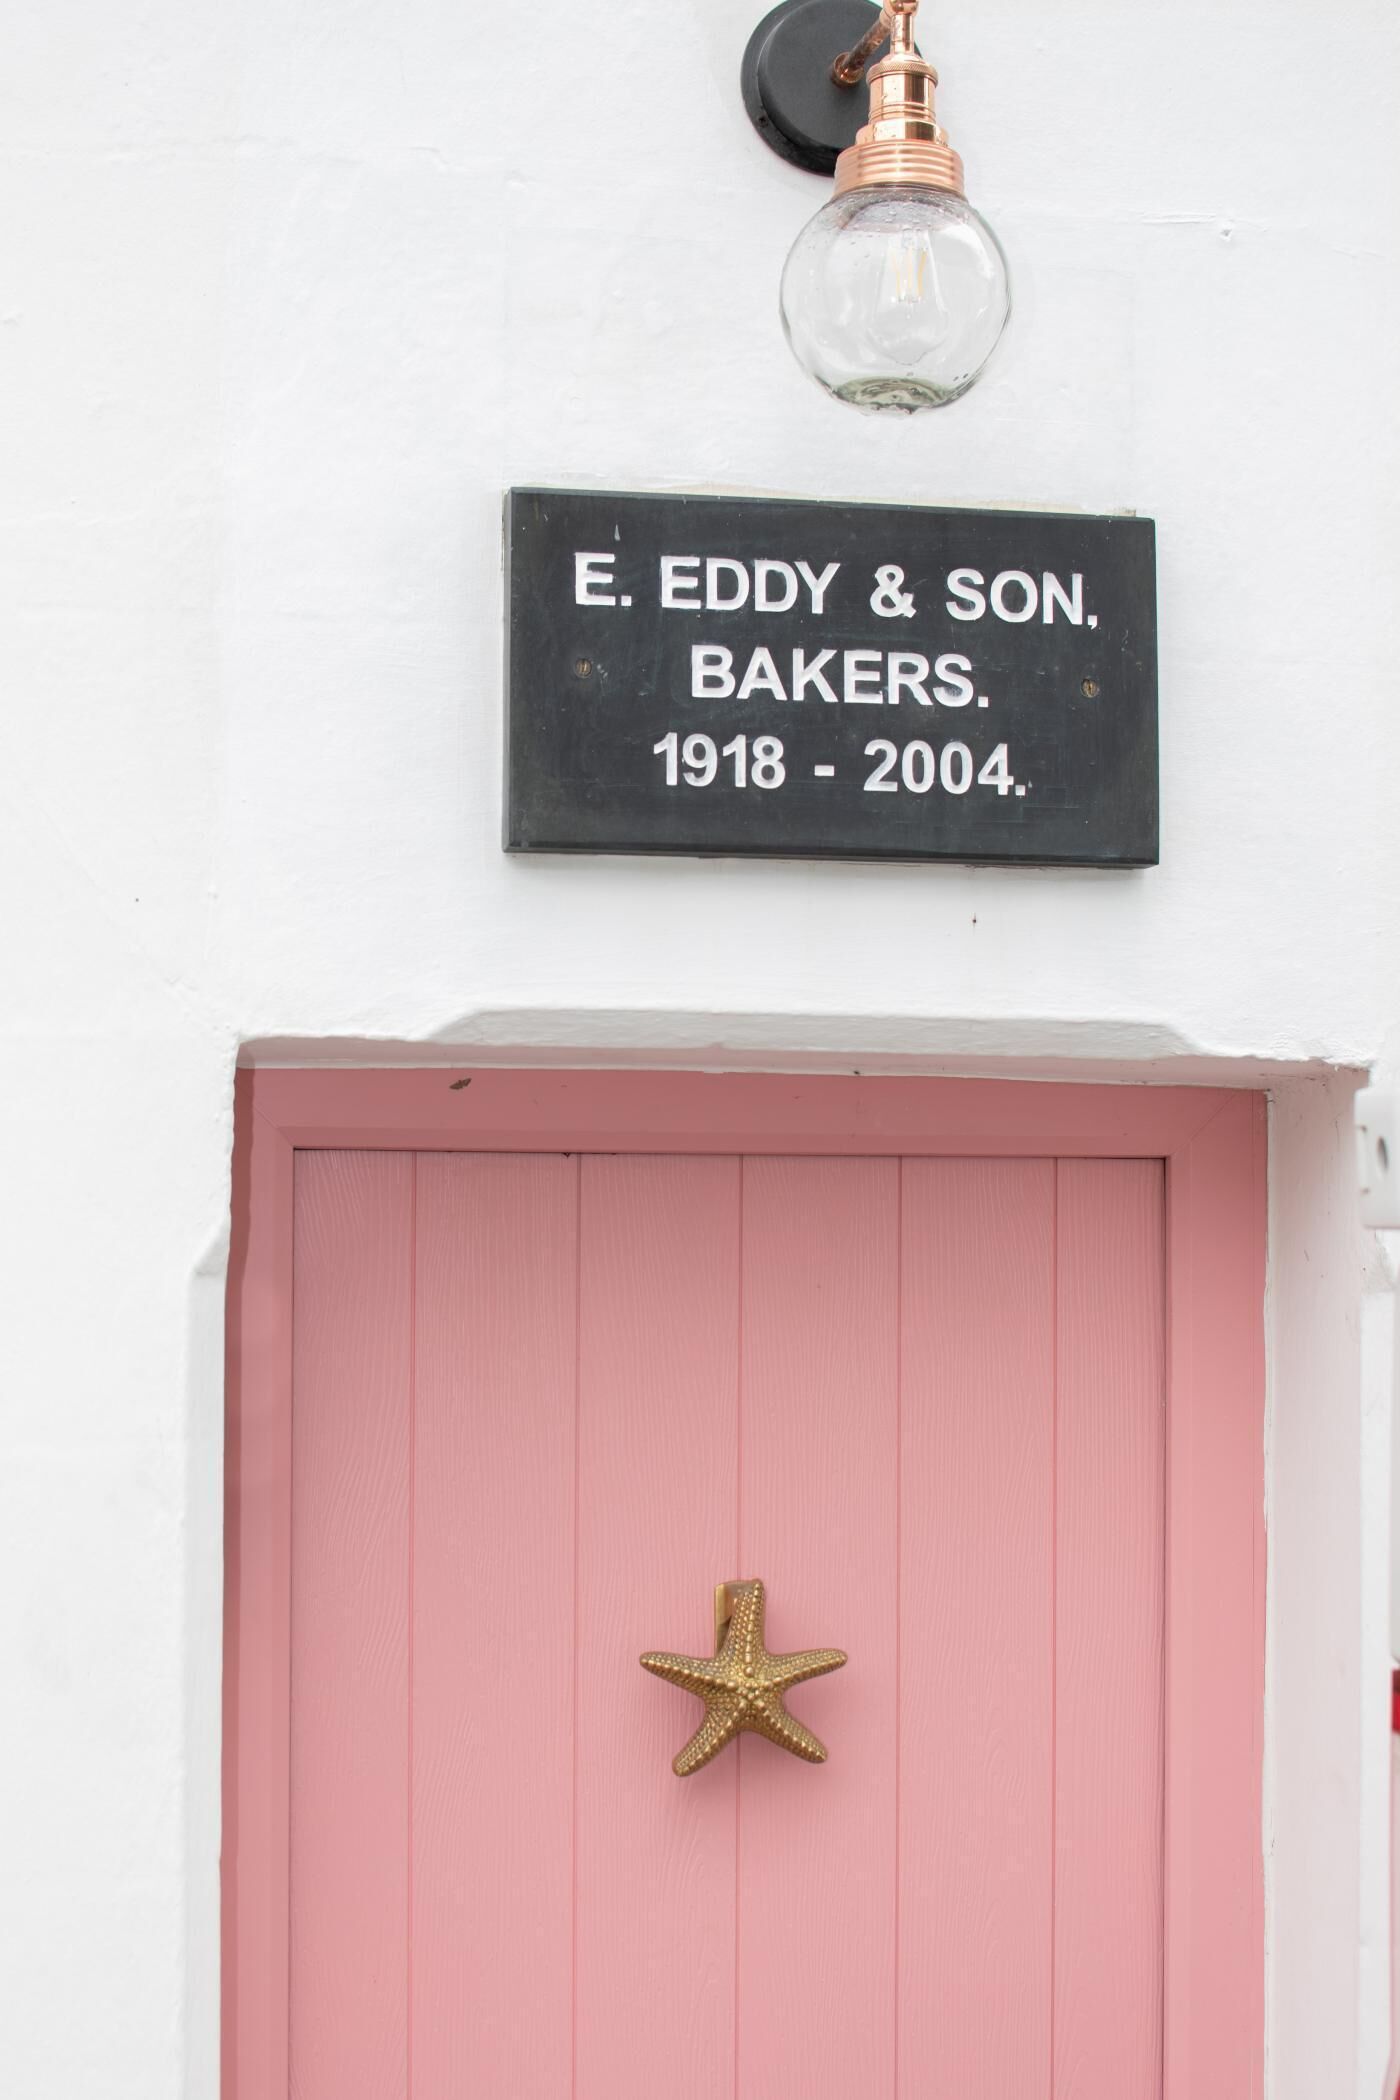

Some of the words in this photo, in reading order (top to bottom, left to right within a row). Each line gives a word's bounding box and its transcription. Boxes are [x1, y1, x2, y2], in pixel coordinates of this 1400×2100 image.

[573, 551, 633, 607] E.
[659, 555, 841, 615] EDDY
[869, 564, 917, 619] &
[945, 567, 1098, 630] SON,
[690, 644, 989, 708] BAKERS.
[653, 731, 786, 790] 1918
[813, 764, 835, 777] -
[863, 738, 1026, 797] 2004.
